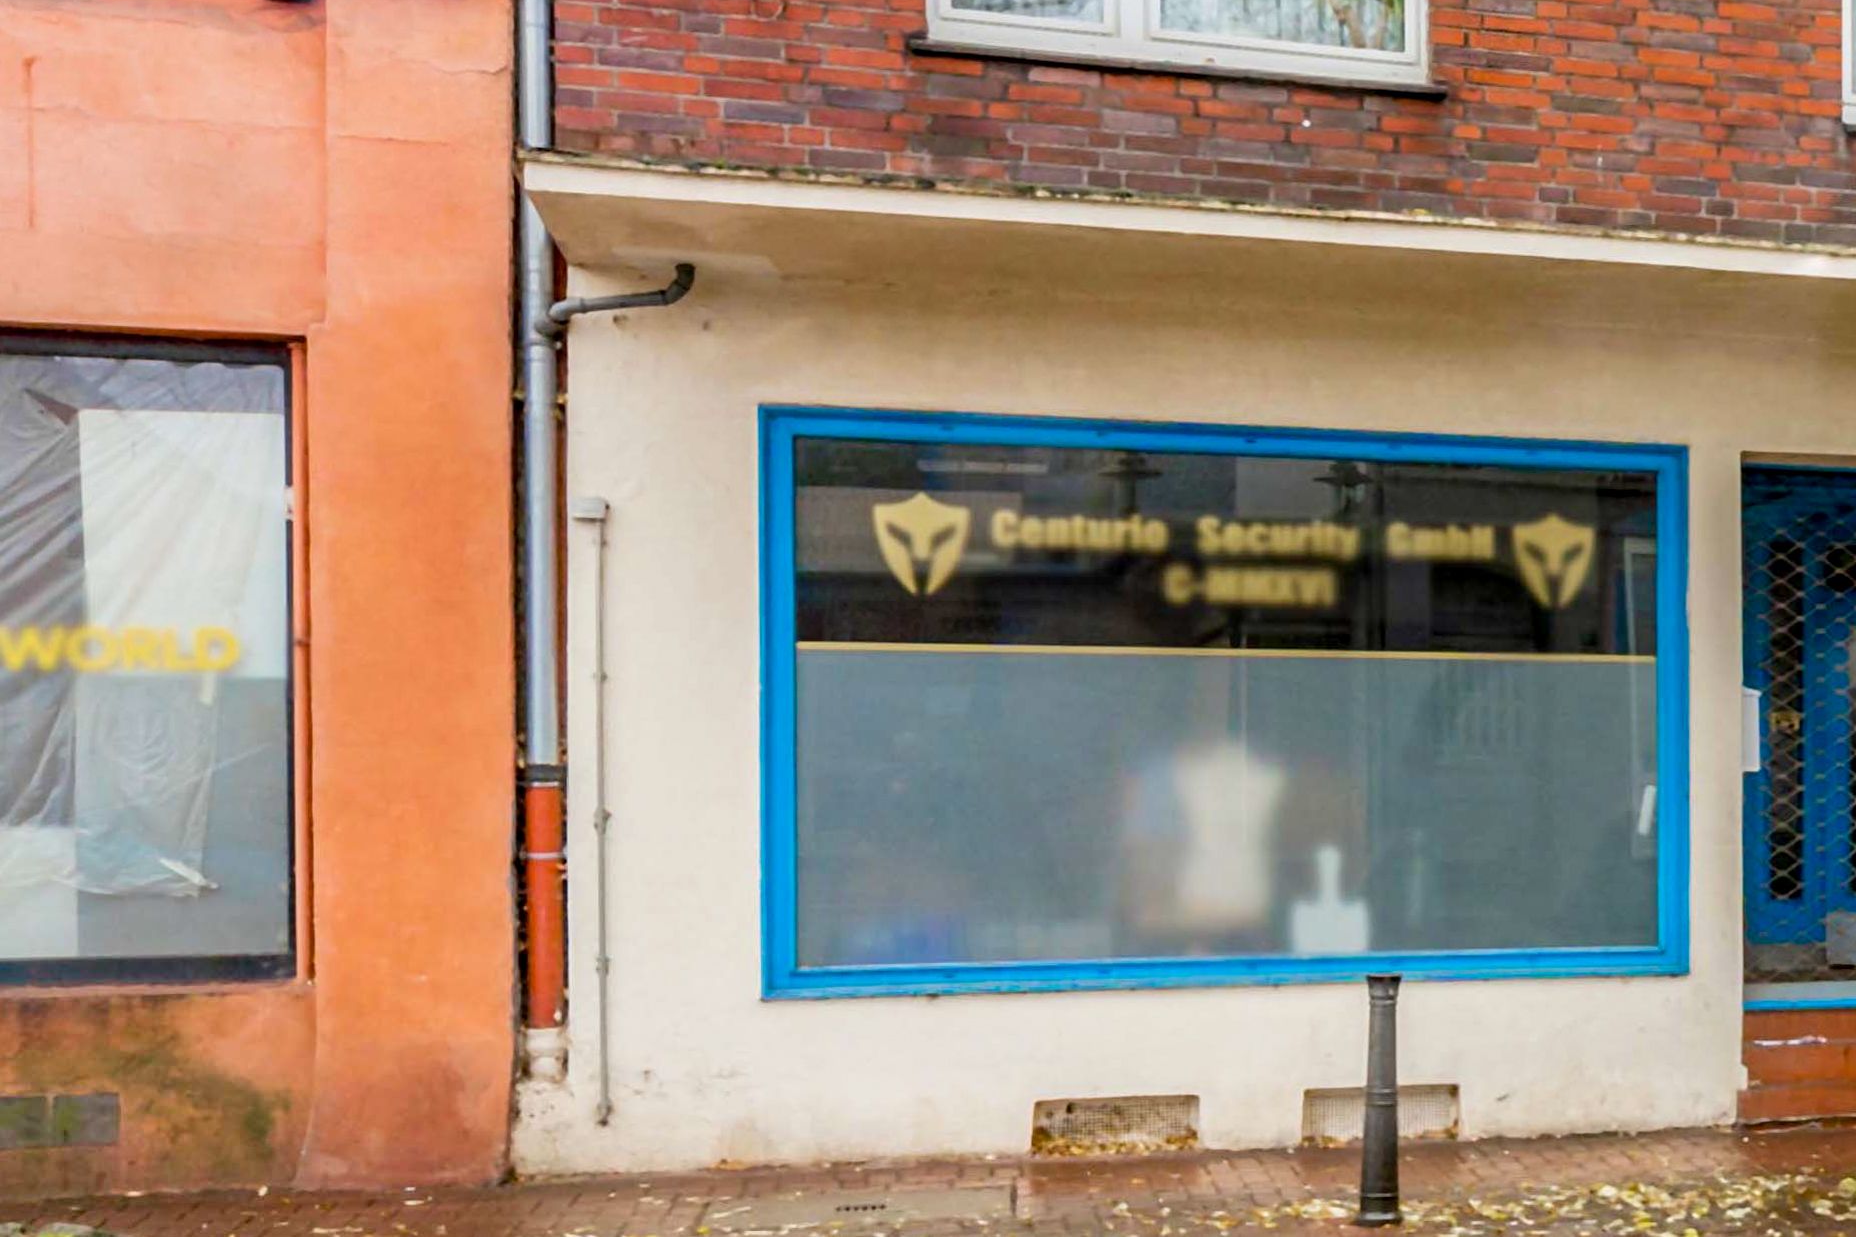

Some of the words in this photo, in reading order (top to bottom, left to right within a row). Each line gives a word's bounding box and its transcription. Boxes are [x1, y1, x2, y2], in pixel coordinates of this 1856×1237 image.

[992, 509, 1168, 553] Centurio
[1196, 516, 1359, 560] Security
[1387, 522, 1495, 560] GmbH
[0, 625, 240, 673] WORLD
